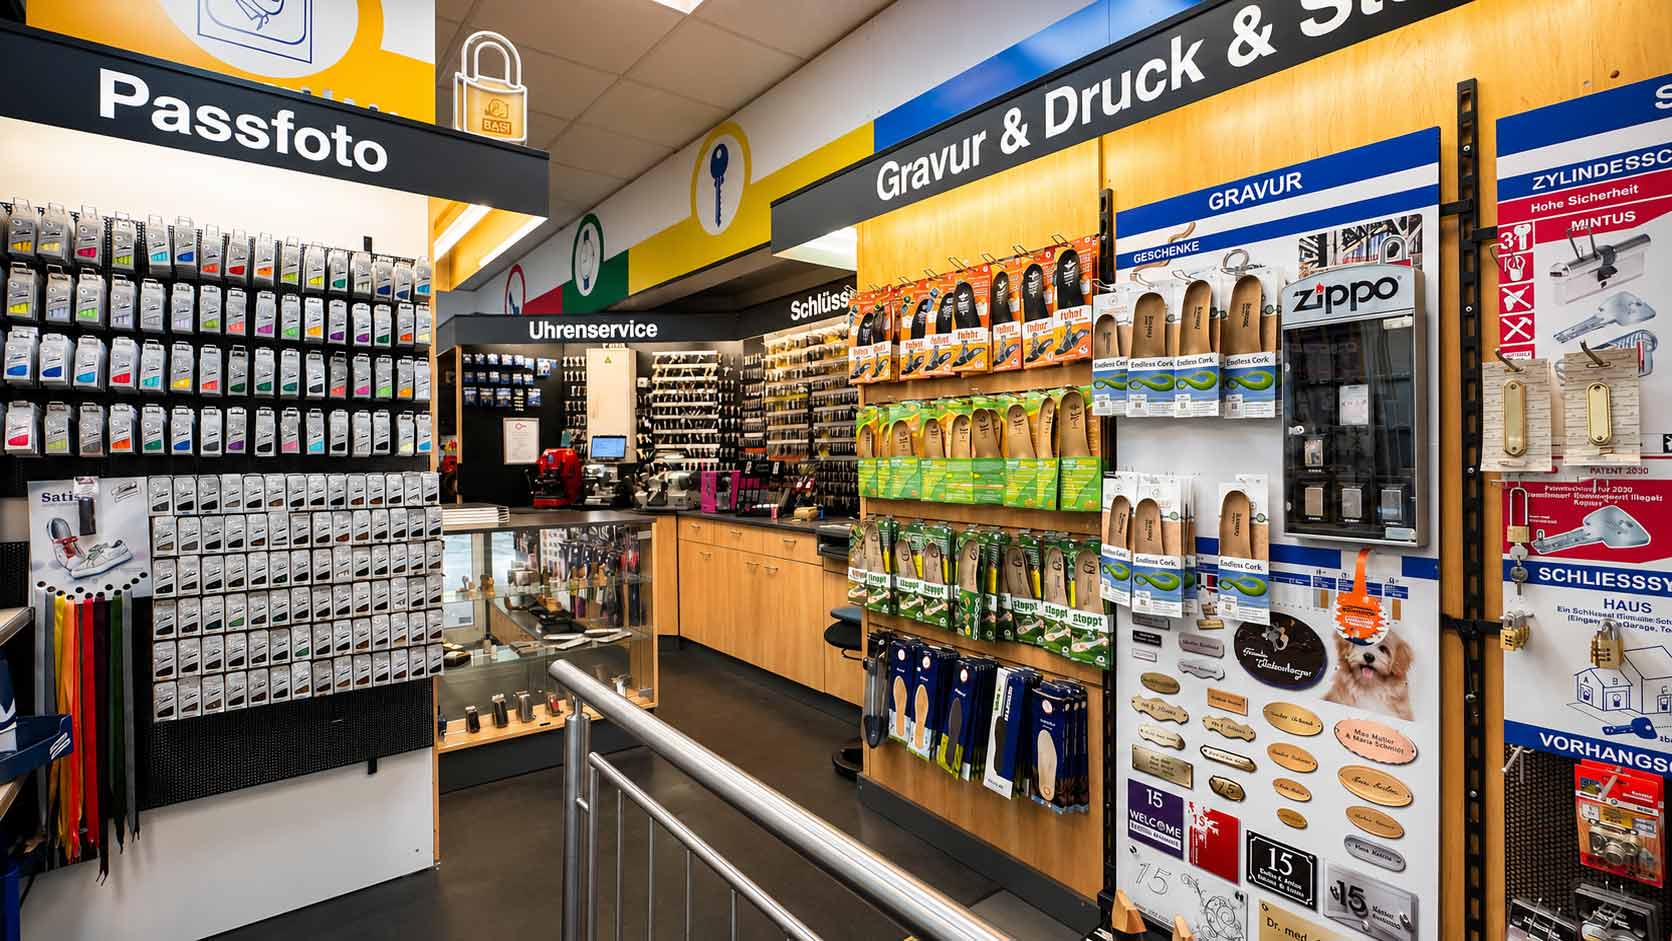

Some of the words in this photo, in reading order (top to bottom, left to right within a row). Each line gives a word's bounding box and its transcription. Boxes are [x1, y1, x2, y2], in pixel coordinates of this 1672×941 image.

[876, 131, 987, 201] Gravur
[1000, 107, 1030, 155] &
[1045, 34, 1205, 137] Druck
[1227, 5, 1278, 68] &
[100, 68, 389, 173] Passfoto
[1208, 171, 1303, 212] GRAVUR
[1531, 201, 1564, 213] Hohe
[1568, 184, 1639, 206] Sicherheit
[1571, 210, 1637, 231] MINTUS
[1133, 240, 1200, 264] GESCHENKE
[791, 291, 850, 321] Schlüss
[529, 320, 658, 339] Uhrenservice
[1252, 356, 1270, 364] Cork
[1072, 613, 1103, 626] stoppt
[1603, 598, 1653, 614] HAUS
[1540, 732, 1672, 773] VORHANGS
[1146, 788, 1163, 809] 15
[1268, 847, 1293, 876] 15
[1135, 863, 1172, 895] 15
[1336, 880, 1369, 917] 15
[1266, 916, 1280, 931] Dr.
